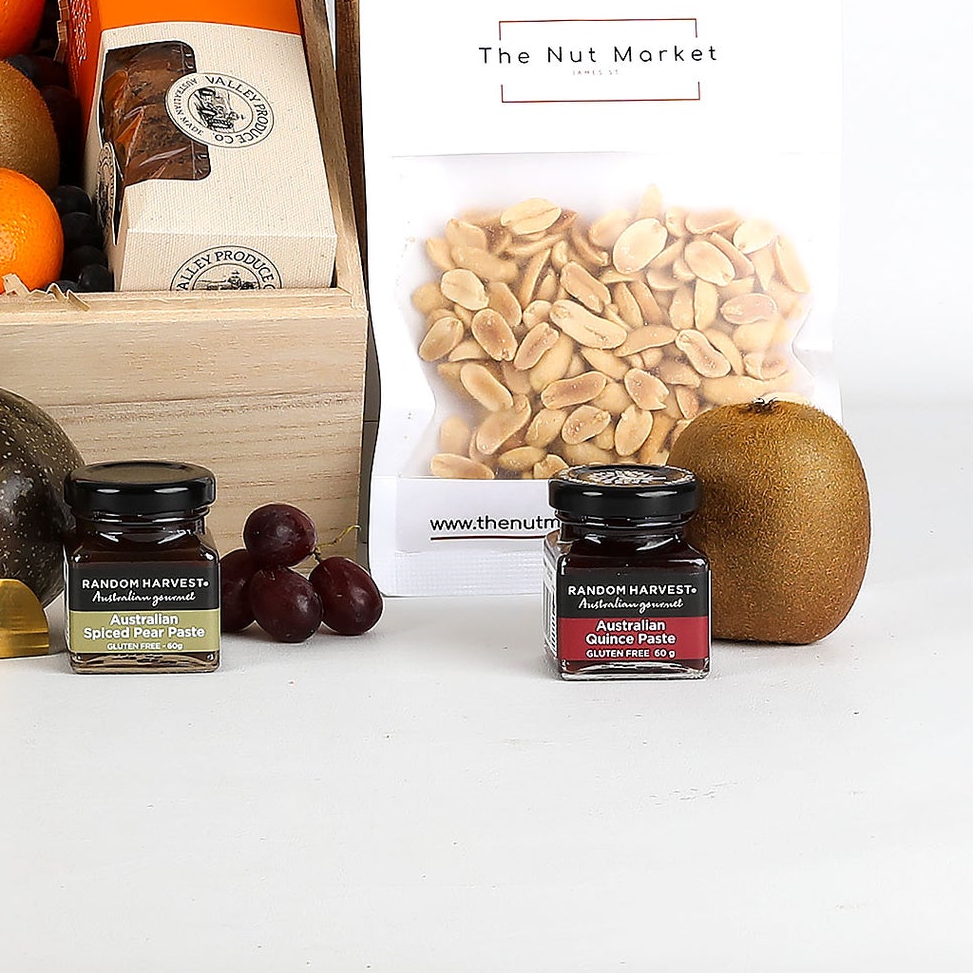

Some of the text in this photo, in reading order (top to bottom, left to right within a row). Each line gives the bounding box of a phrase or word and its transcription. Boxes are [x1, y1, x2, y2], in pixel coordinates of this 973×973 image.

[478, 45, 717, 64] The Nut Market
[204, 75, 261, 102] VALLEY
[234, 103, 269, 144] PRODUCE
[176, 250, 275, 290] ALLEY PRODUCE
[82, 578, 139, 589] RANDOM
[568, 585, 626, 595] RANDOM
[92, 590, 196, 607] Australian gourmet
[578, 597, 684, 614] Australian gourmet
[110, 613, 179, 626] Australian
[596, 619, 665, 632] Australian
[84, 627, 205, 640] Spiced Pear Paste
[585, 633, 676, 645] Quince Paste
[107, 642, 139, 650] GLUTEN
[167, 642, 183, 650] 60g
[586, 649, 625, 658] GLUTEN
[626, 649, 650, 657] FREE
